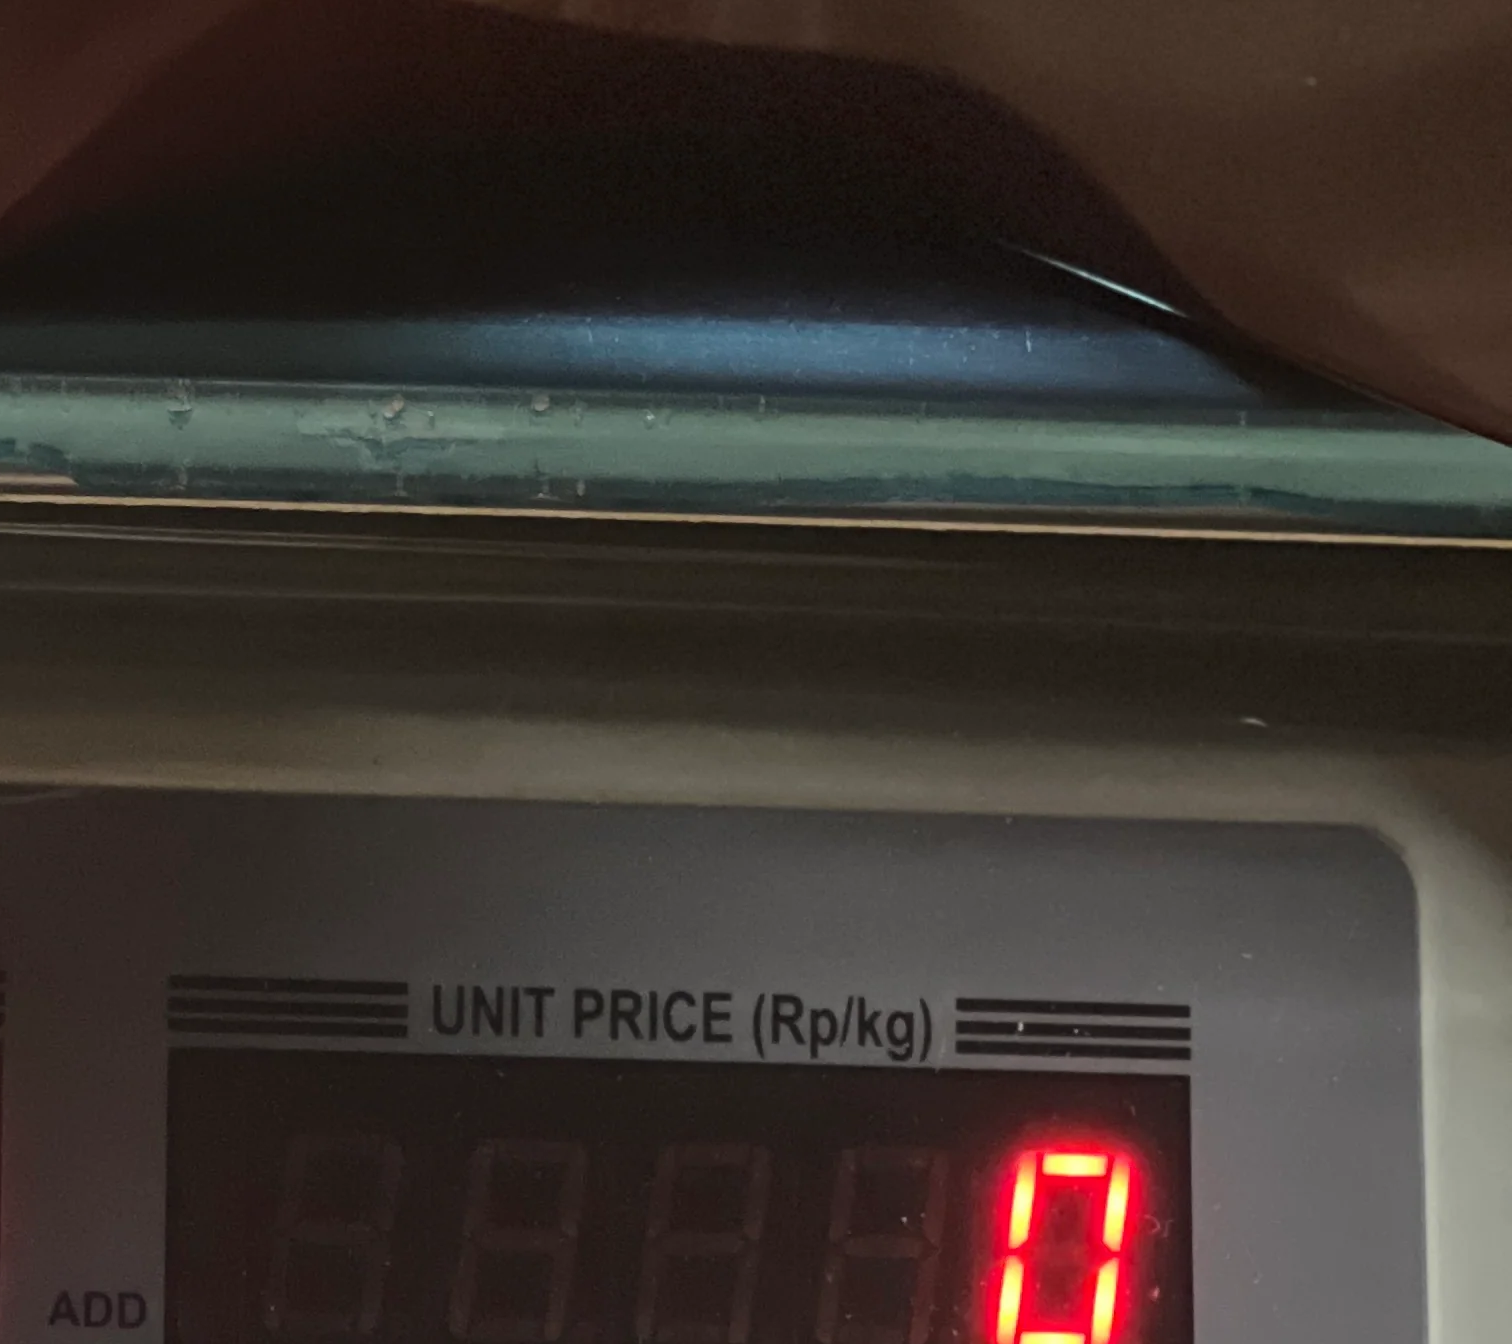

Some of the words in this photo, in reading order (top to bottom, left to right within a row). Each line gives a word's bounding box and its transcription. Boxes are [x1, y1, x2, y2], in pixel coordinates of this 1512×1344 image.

[431, 985, 556, 1039] UNIT
[572, 988, 734, 1045] PRICE
[752, 991, 934, 1061] (Rp/kg)
[48, 1292, 148, 1332] ADD
